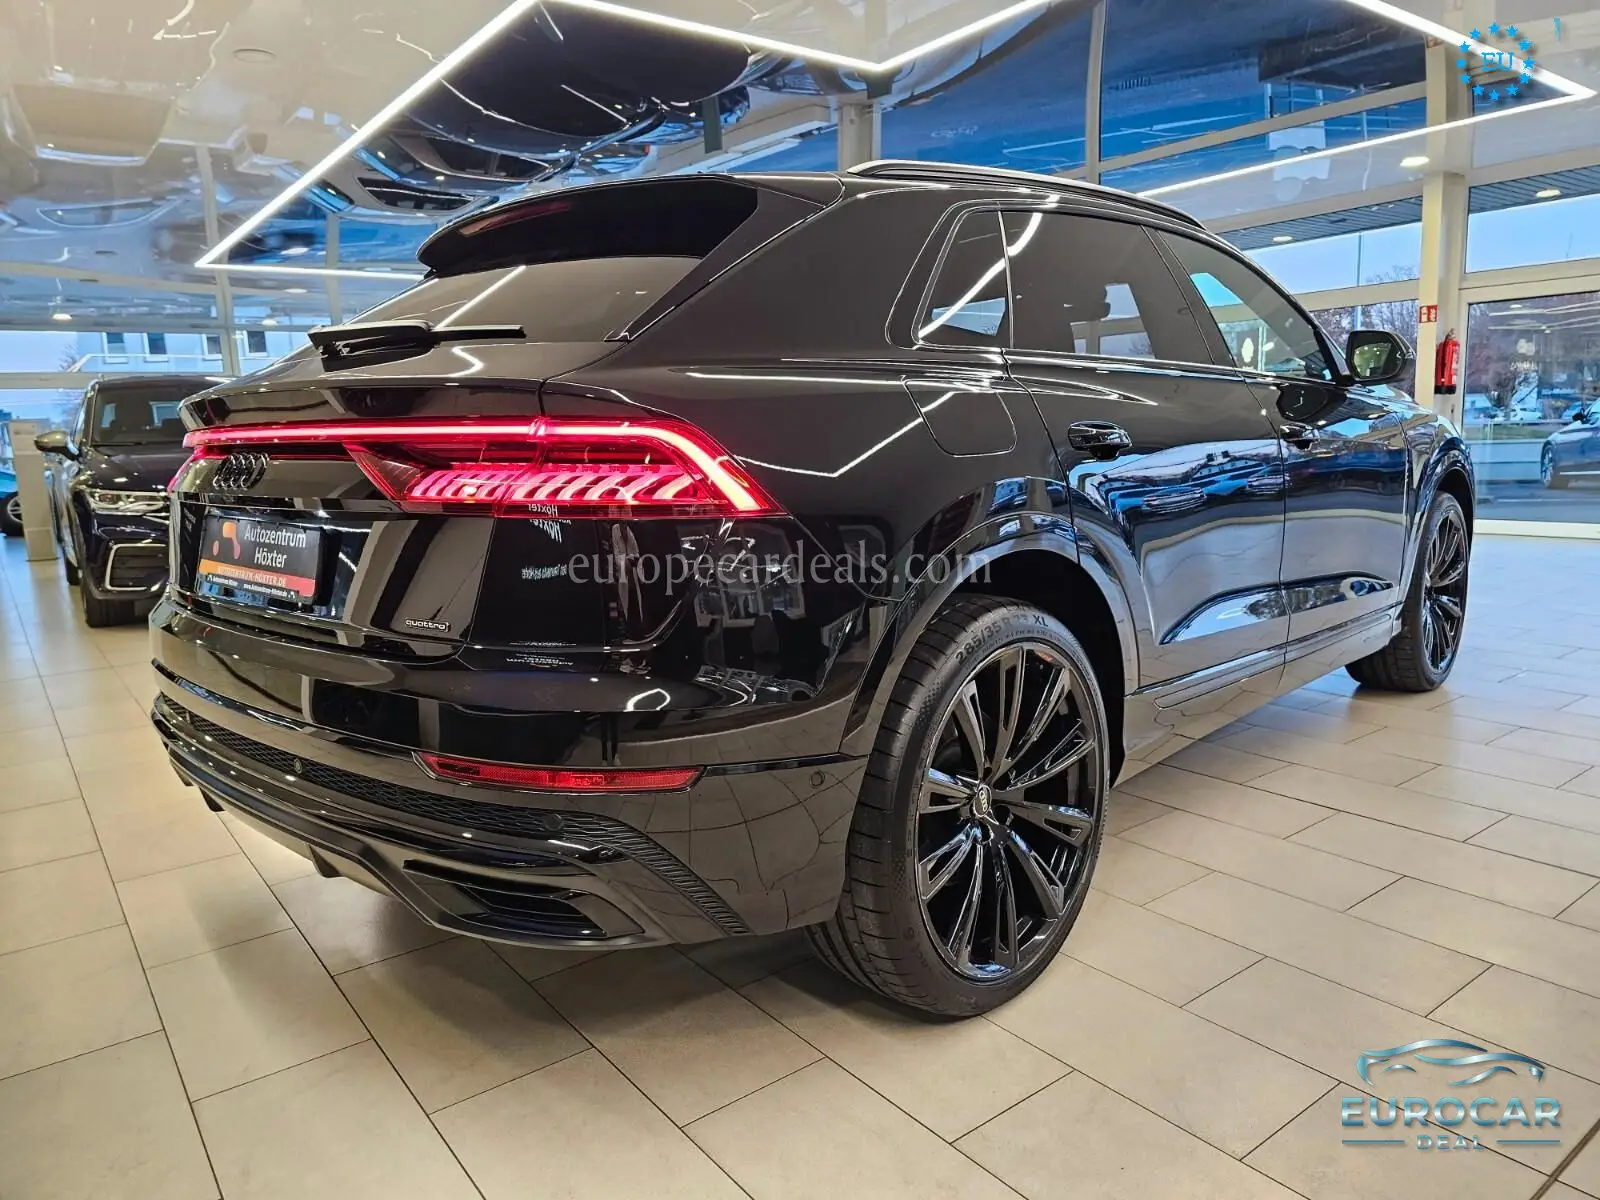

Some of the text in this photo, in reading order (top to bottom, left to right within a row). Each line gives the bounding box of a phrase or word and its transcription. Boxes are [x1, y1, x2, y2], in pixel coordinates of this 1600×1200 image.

[244, 525, 306, 548] Autozentrum
[254, 547, 288, 568] Höxter
[405, 619, 446, 630] quattro
[955, 621, 1003, 663] 285/35
[1001, 616, 1012, 628] R
[1032, 614, 1049, 628] XL
